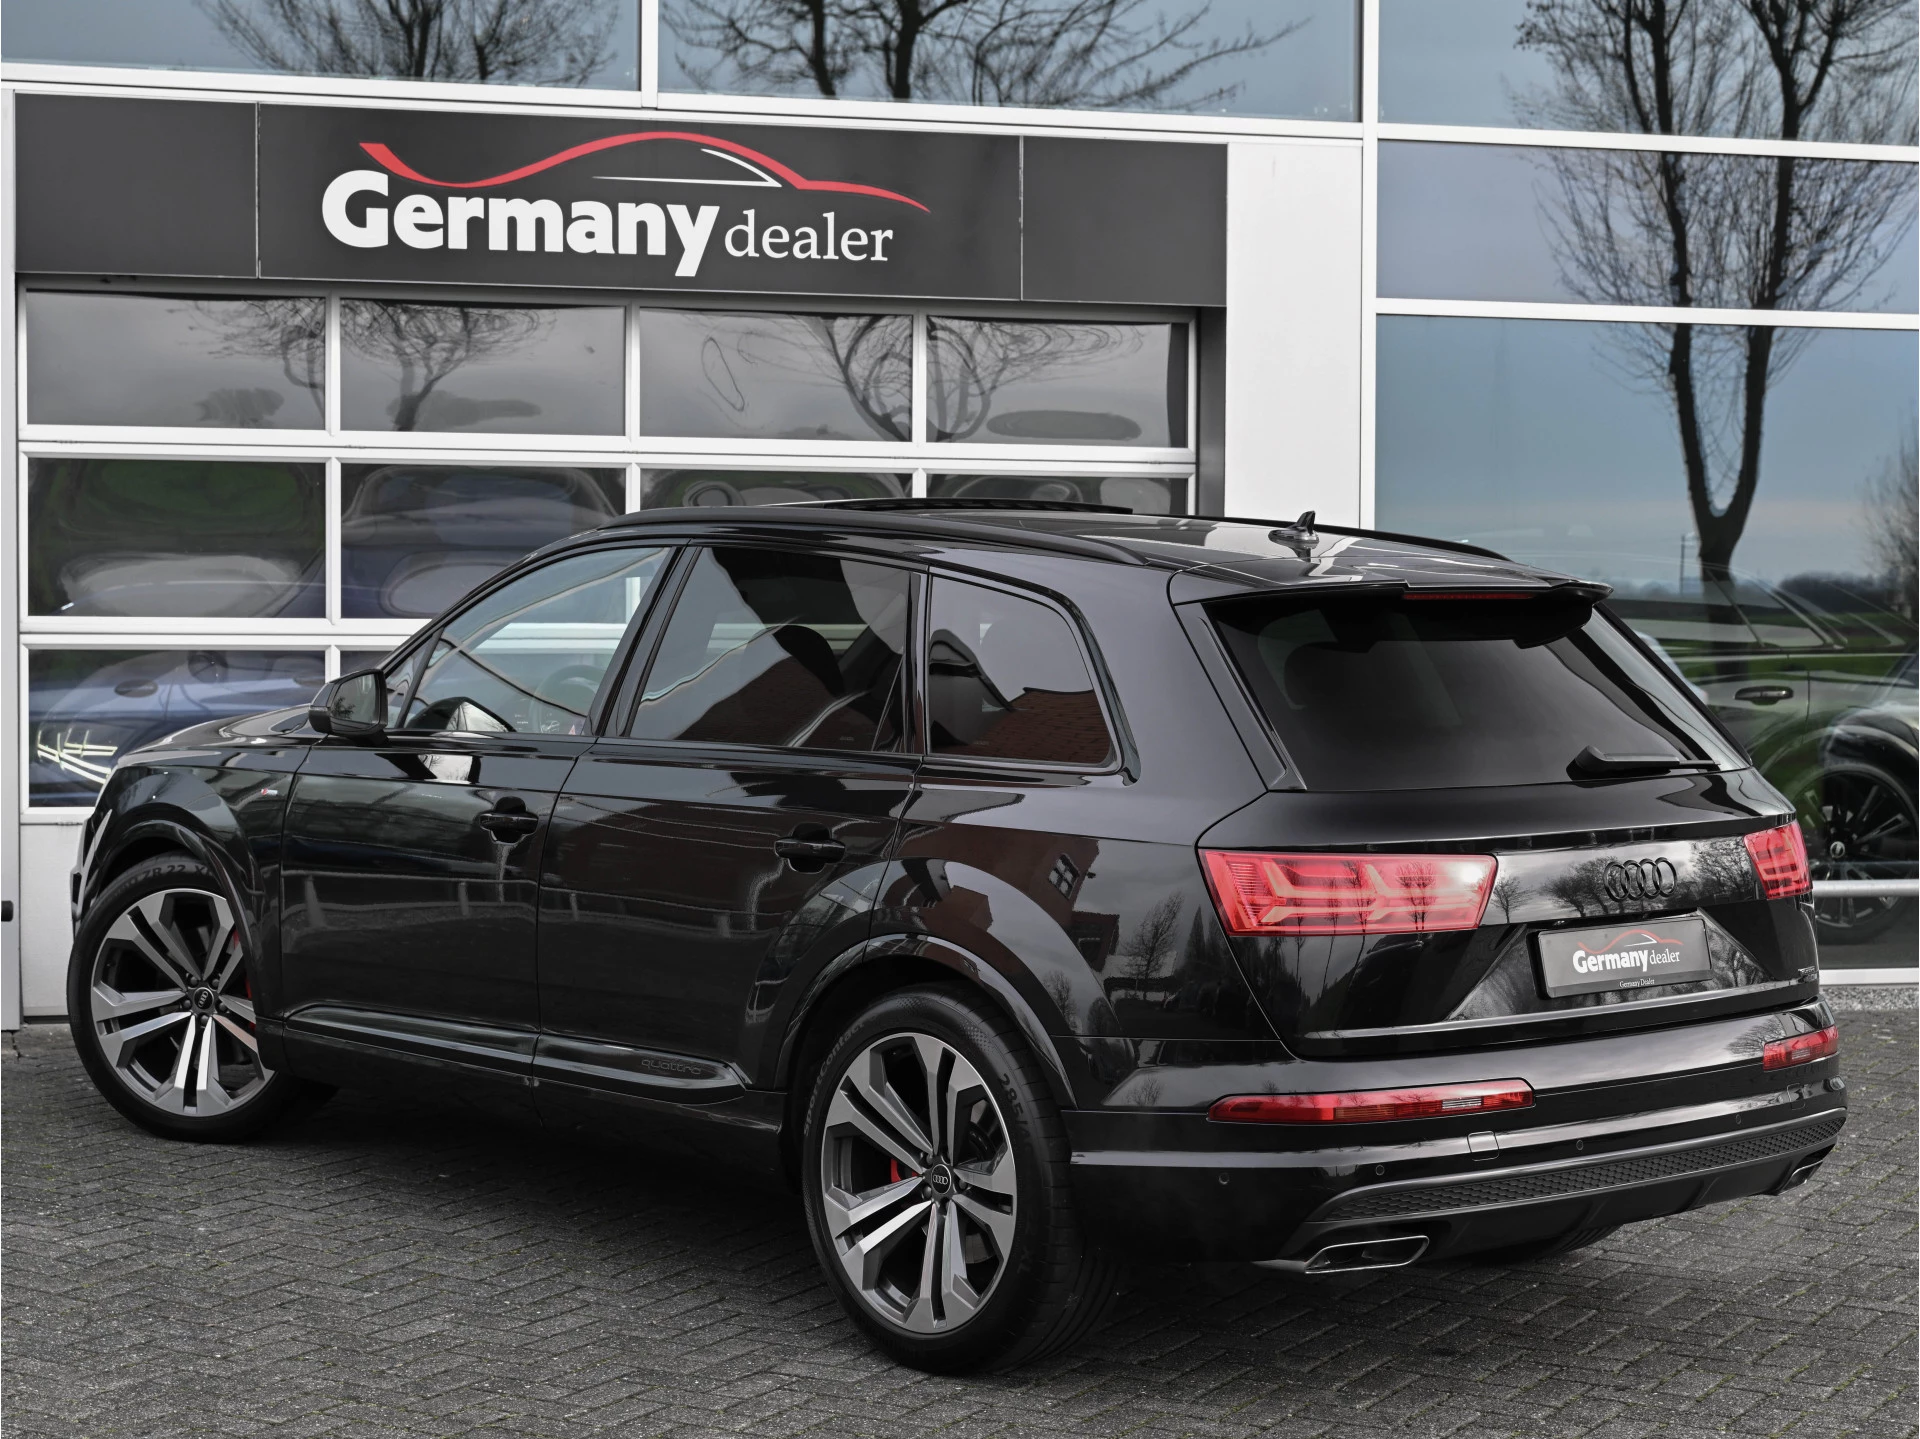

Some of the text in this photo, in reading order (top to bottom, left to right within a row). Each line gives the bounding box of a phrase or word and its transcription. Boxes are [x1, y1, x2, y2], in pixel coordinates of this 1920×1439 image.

[321, 169, 894, 277] Germany dealer
[1572, 949, 1680, 973] Germany dealer
[1619, 977, 1655, 988] Germany Dealer
[641, 1059, 701, 1075] quattro
